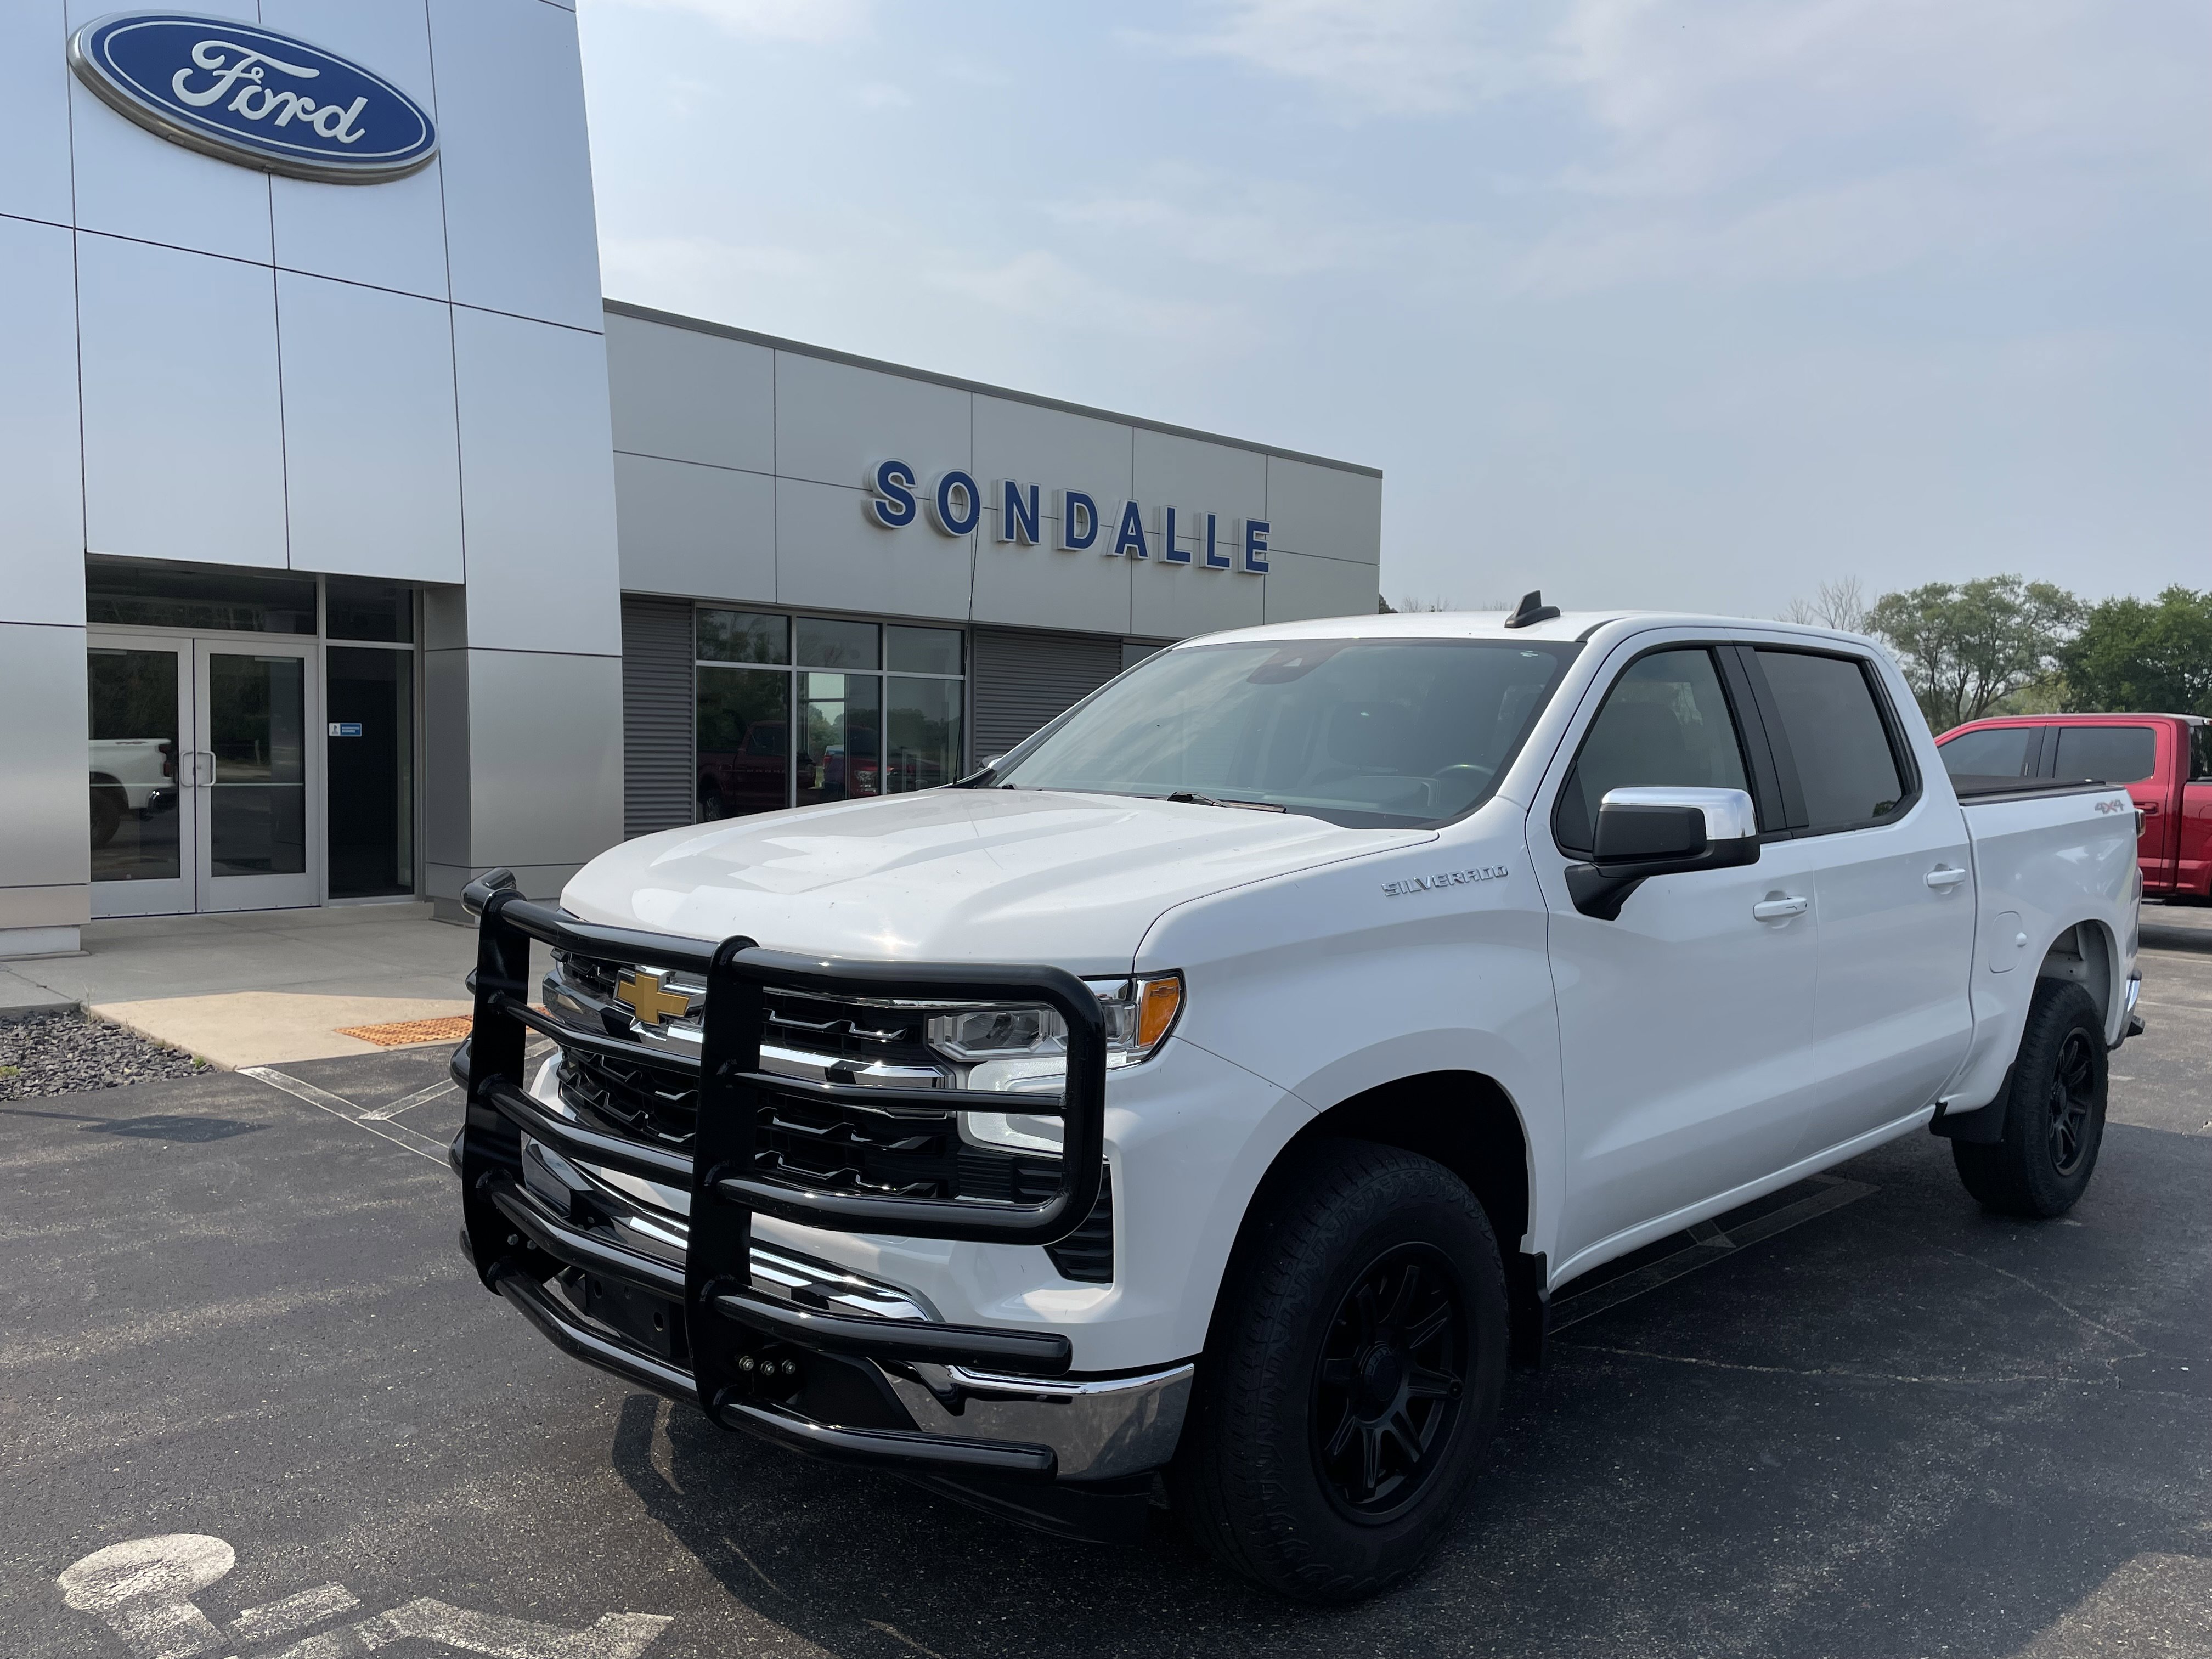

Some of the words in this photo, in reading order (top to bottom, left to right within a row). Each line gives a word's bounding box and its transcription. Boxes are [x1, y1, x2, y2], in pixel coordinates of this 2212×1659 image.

[172, 40, 368, 144] Ford
[868, 458, 1271, 574] SONDALLE
[1381, 865, 1509, 897] SILVERADO
